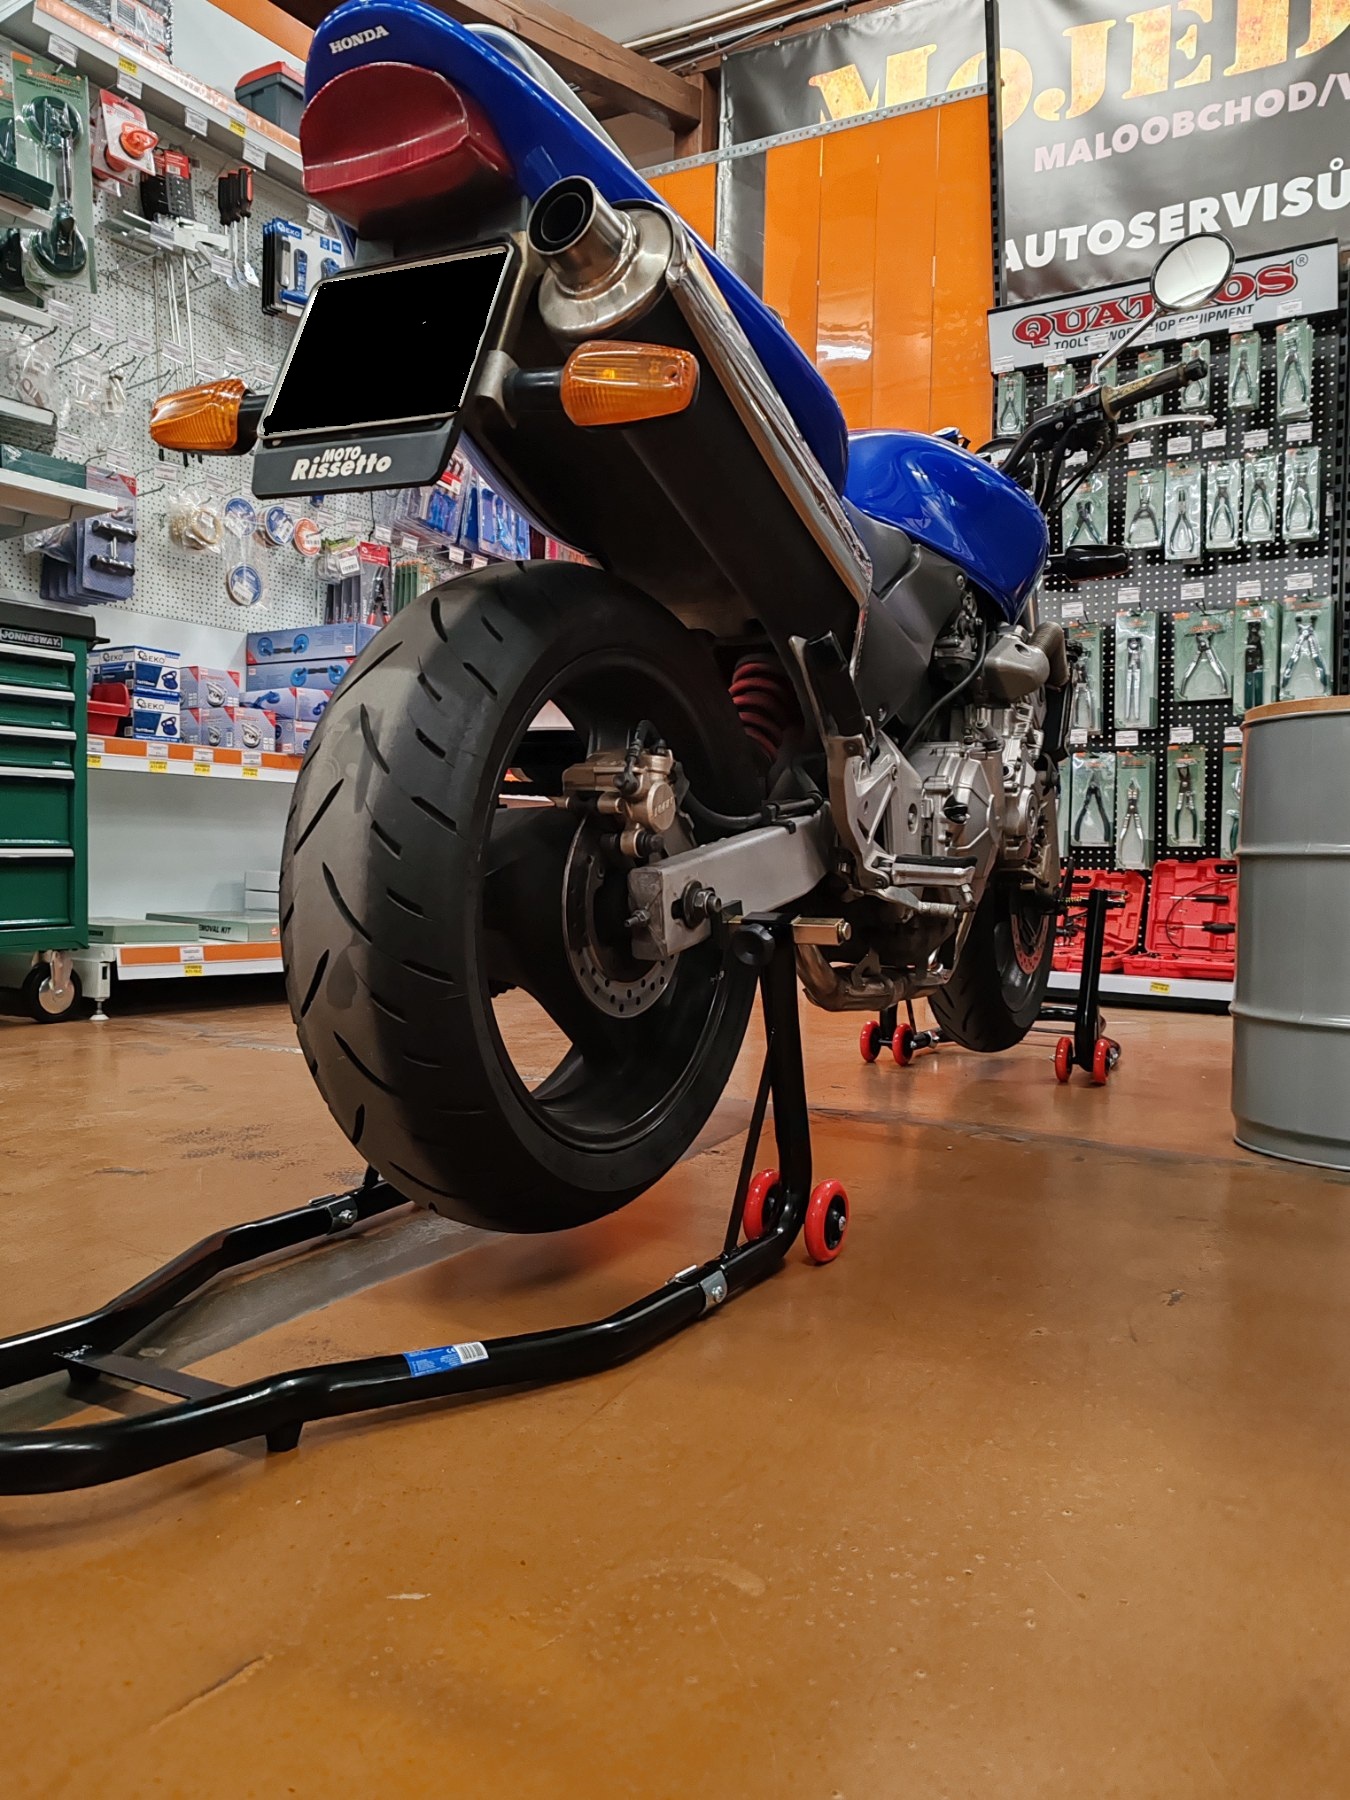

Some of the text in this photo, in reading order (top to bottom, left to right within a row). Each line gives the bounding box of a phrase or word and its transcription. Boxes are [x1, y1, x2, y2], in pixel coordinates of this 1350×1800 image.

[329, 25, 389, 54] HONDA
[1004, 157, 1350, 272] AUTOSERVISŮ
[1013, 260, 1297, 348] QUATOS
[291, 453, 392, 480] Rissetto
[321, 446, 361, 463] MOTO
[137, 651, 165, 664] GEKO
[136, 698, 164, 710] GEKO
